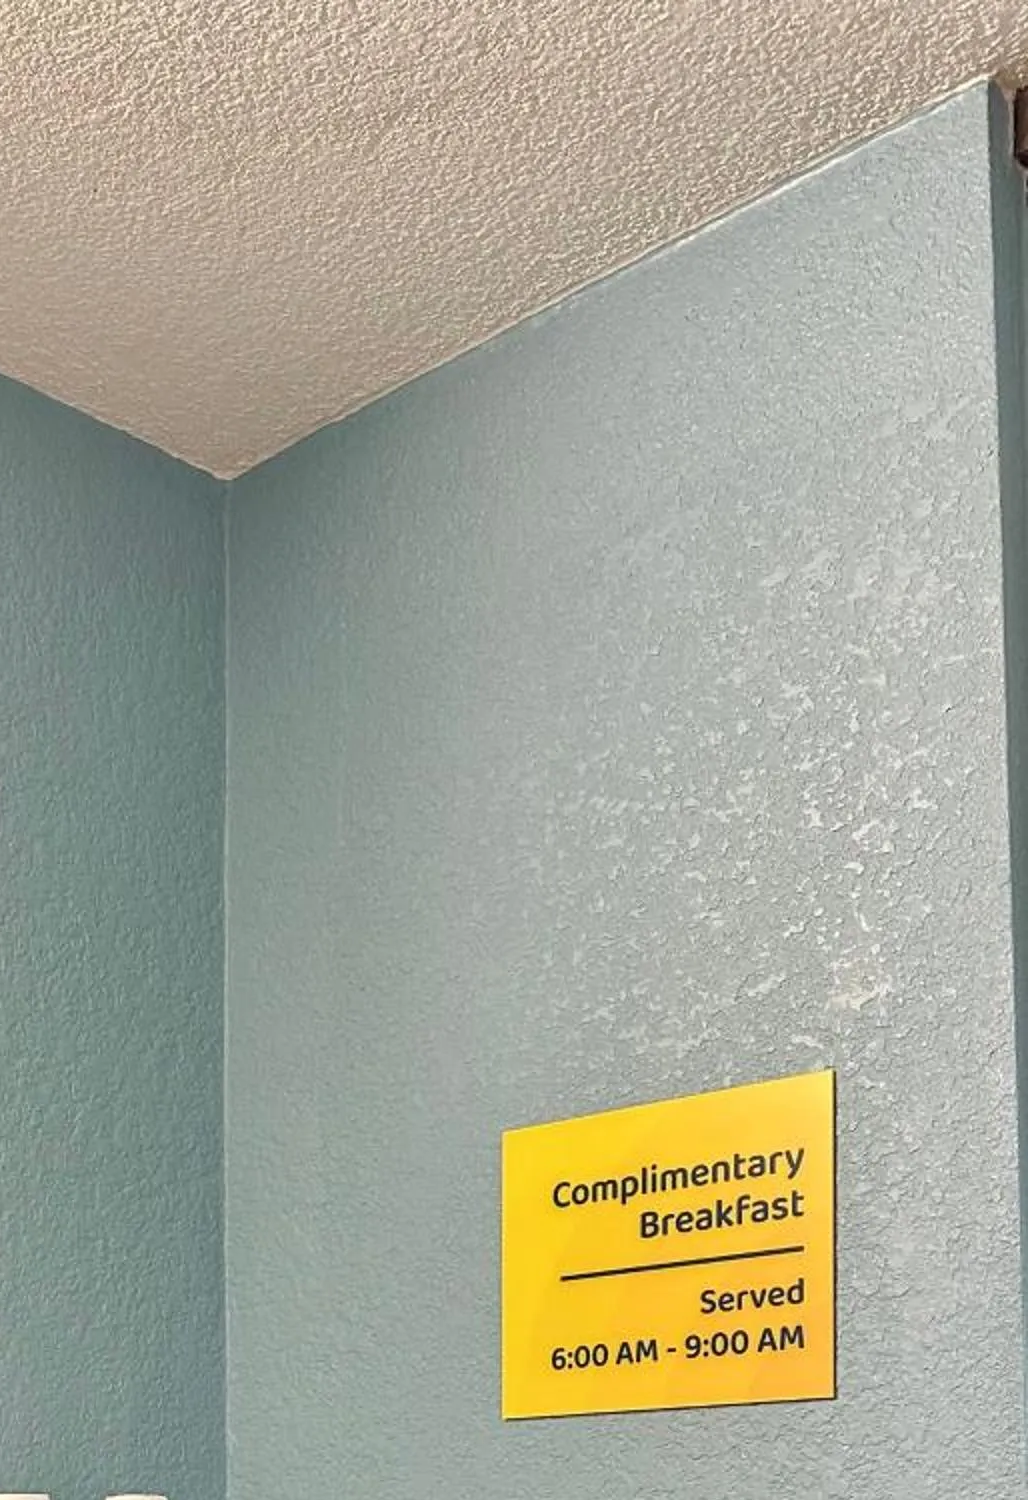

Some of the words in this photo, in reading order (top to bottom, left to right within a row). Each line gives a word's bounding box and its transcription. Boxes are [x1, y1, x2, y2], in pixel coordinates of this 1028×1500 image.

[552, 1147, 805, 1209] Complimentary
[640, 1190, 805, 1239] Breakfast
[700, 1277, 805, 1314] Served
[551, 1342, 609, 1370] 6:00
[615, 1338, 658, 1364] AM
[684, 1329, 749, 1359] 9:00
[757, 1324, 805, 1352] AM
